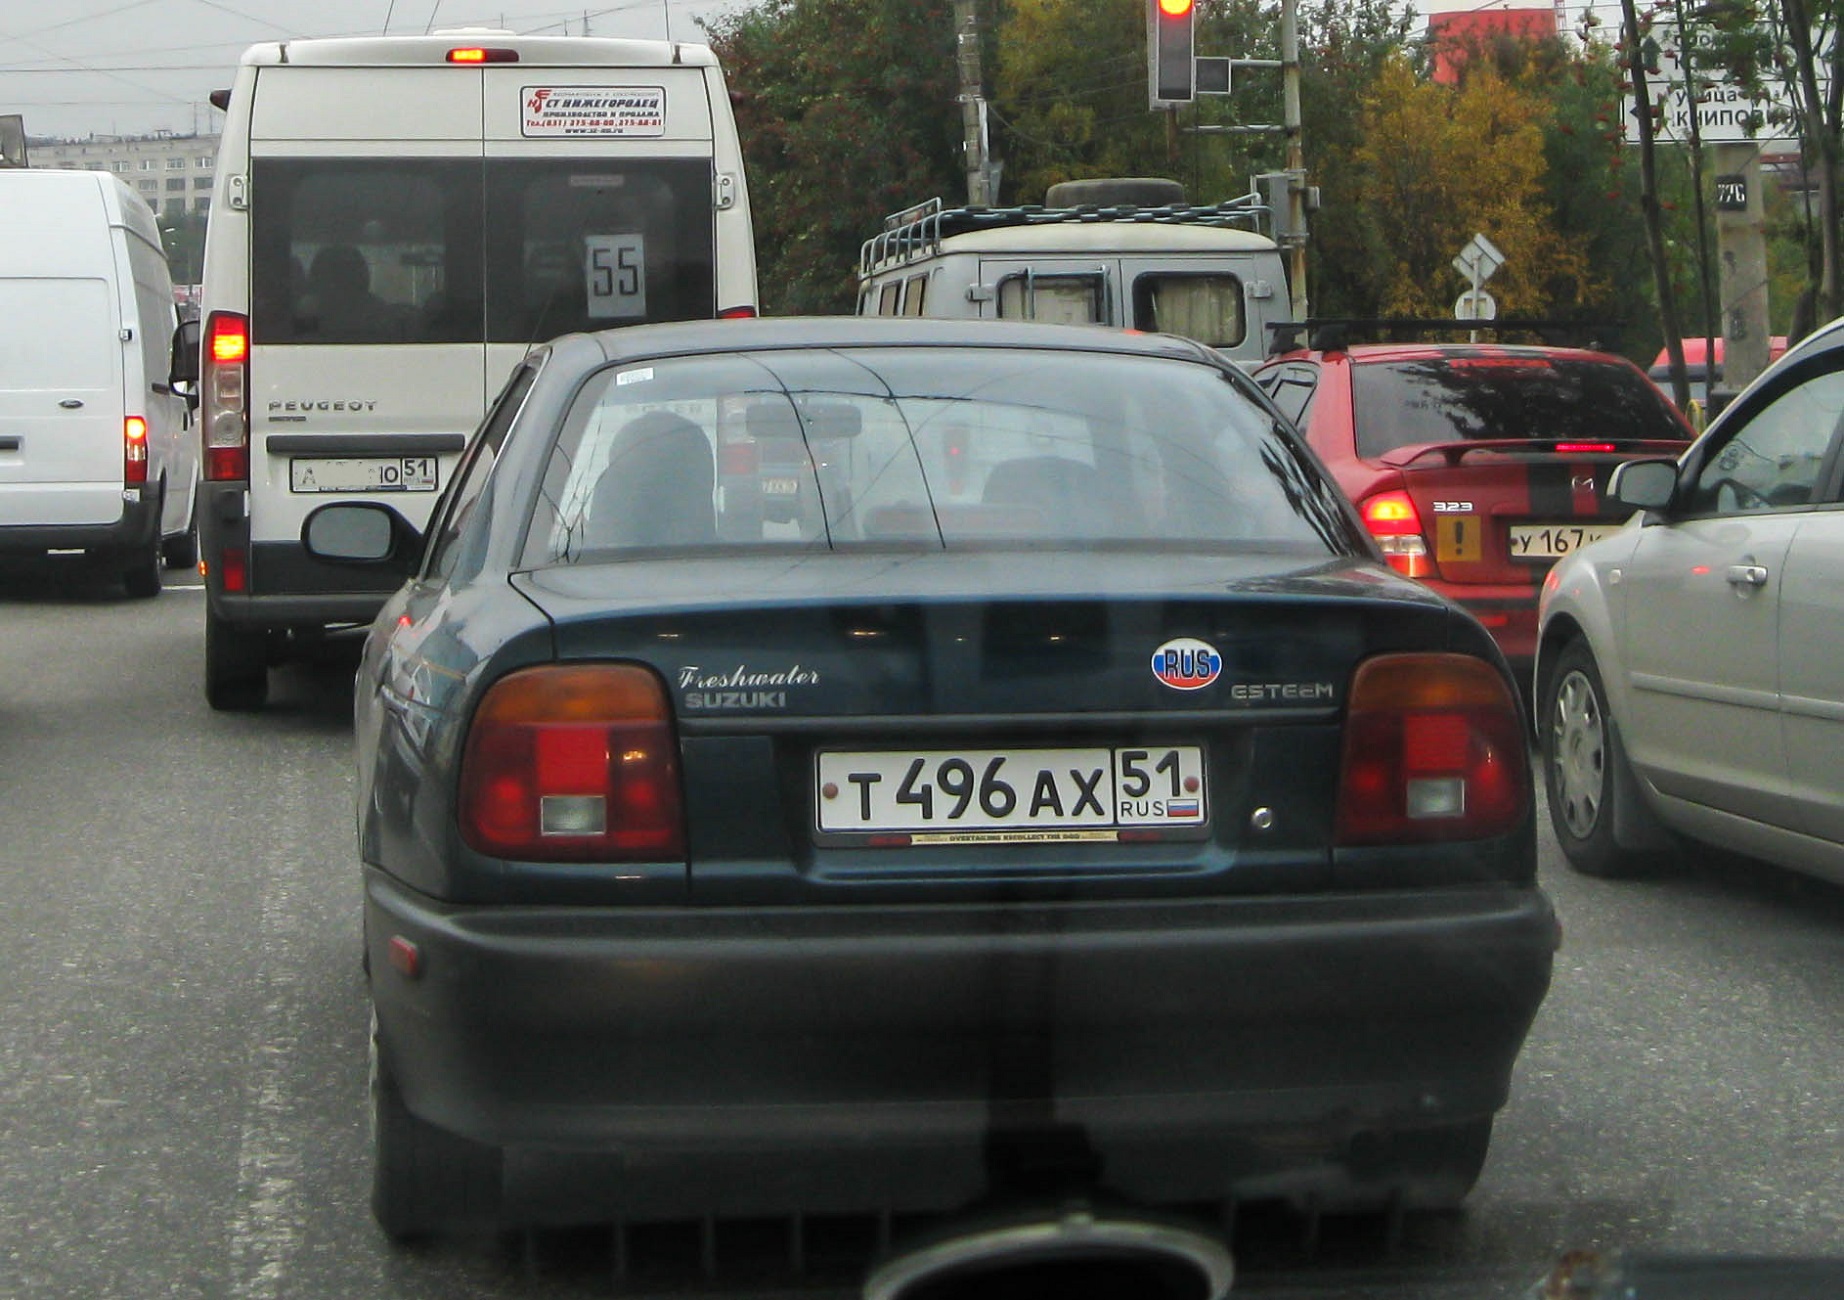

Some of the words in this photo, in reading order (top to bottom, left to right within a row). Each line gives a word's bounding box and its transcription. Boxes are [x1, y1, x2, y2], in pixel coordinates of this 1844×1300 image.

[592, 246, 639, 297] 55
[268, 399, 377, 412] PEUGEOT
[403, 458, 428, 477] 51
[1432, 501, 1474, 512] 323
[1163, 648, 1213, 681] RUS
[677, 664, 820, 690] Freshwater
[684, 691, 787, 709] SUZUKI
[1231, 683, 1334, 700] ESTEEM
[1121, 749, 1182, 798] 51
[1120, 800, 1165, 818] RUS
